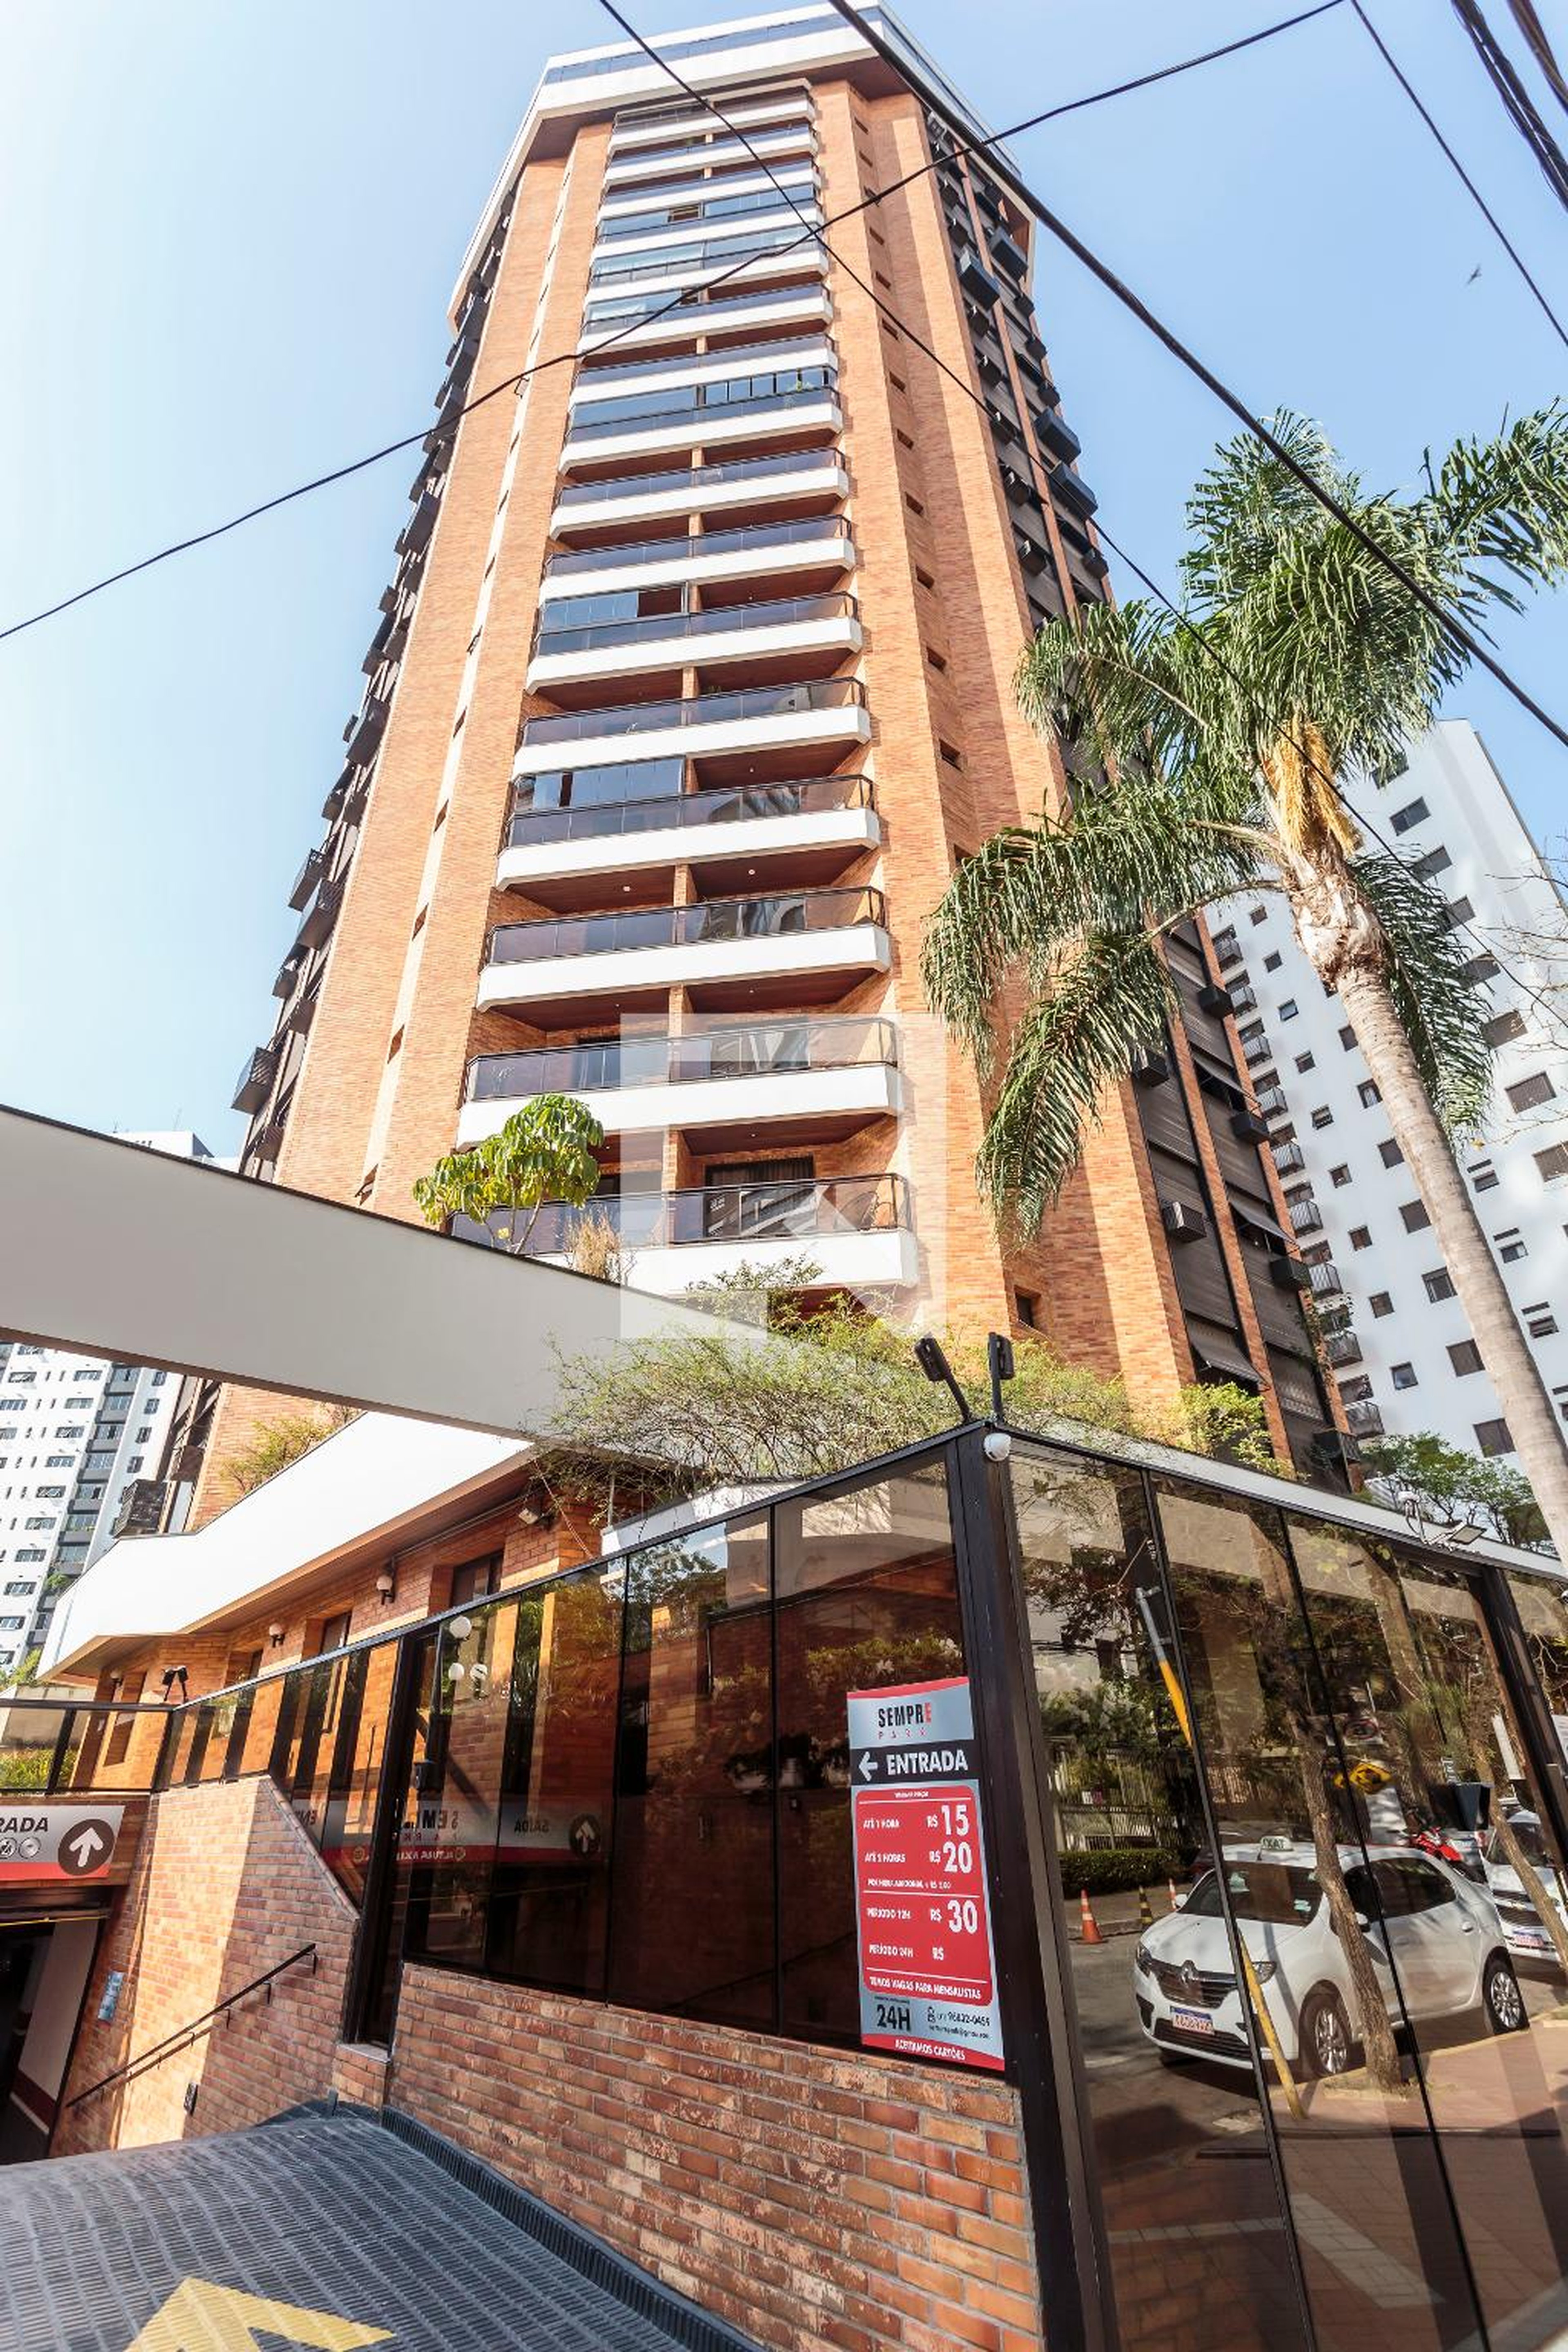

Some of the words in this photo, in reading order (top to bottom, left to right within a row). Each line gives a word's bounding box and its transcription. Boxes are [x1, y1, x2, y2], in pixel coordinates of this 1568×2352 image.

[878, 1702, 931, 1728] SEMPRE
[886, 1749, 968, 1775] ENTRADA
[927, 1815, 938, 1828] R$
[942, 1804, 970, 1836] 15
[943, 1841, 973, 1873] 20
[930, 1908, 942, 1922] R$
[948, 1900, 978, 1934] 30
[877, 2004, 911, 2031] 24H
